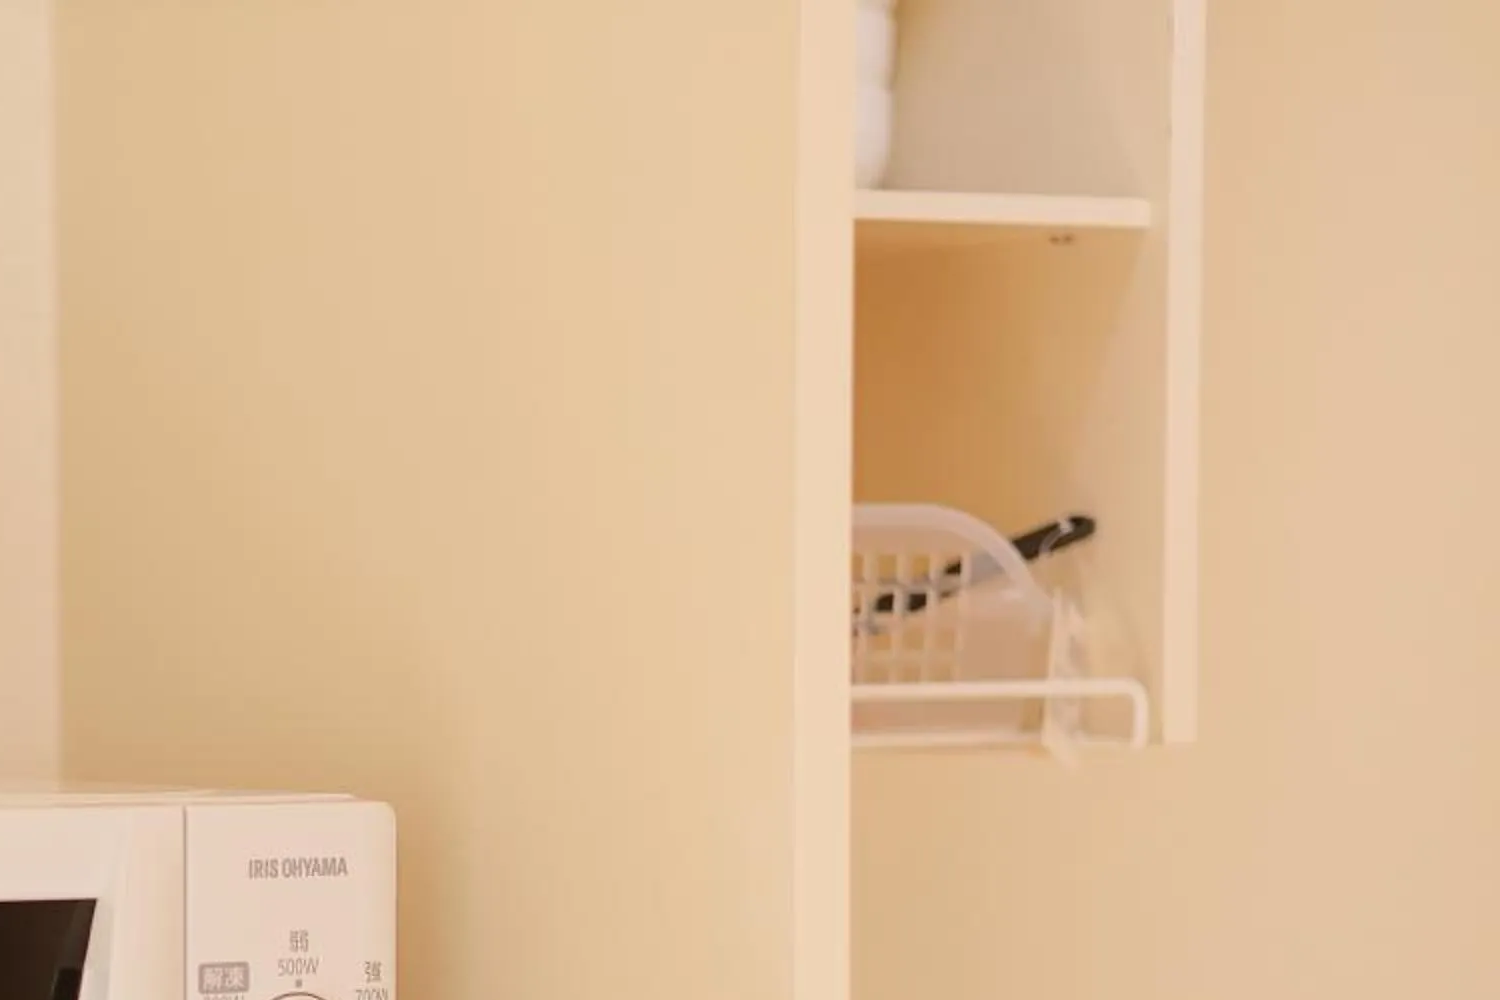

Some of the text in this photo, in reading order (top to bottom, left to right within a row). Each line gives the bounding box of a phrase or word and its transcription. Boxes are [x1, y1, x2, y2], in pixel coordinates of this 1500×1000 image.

[249, 857, 348, 878] IRIS OHYAMA
[277, 957, 319, 977] 500W
